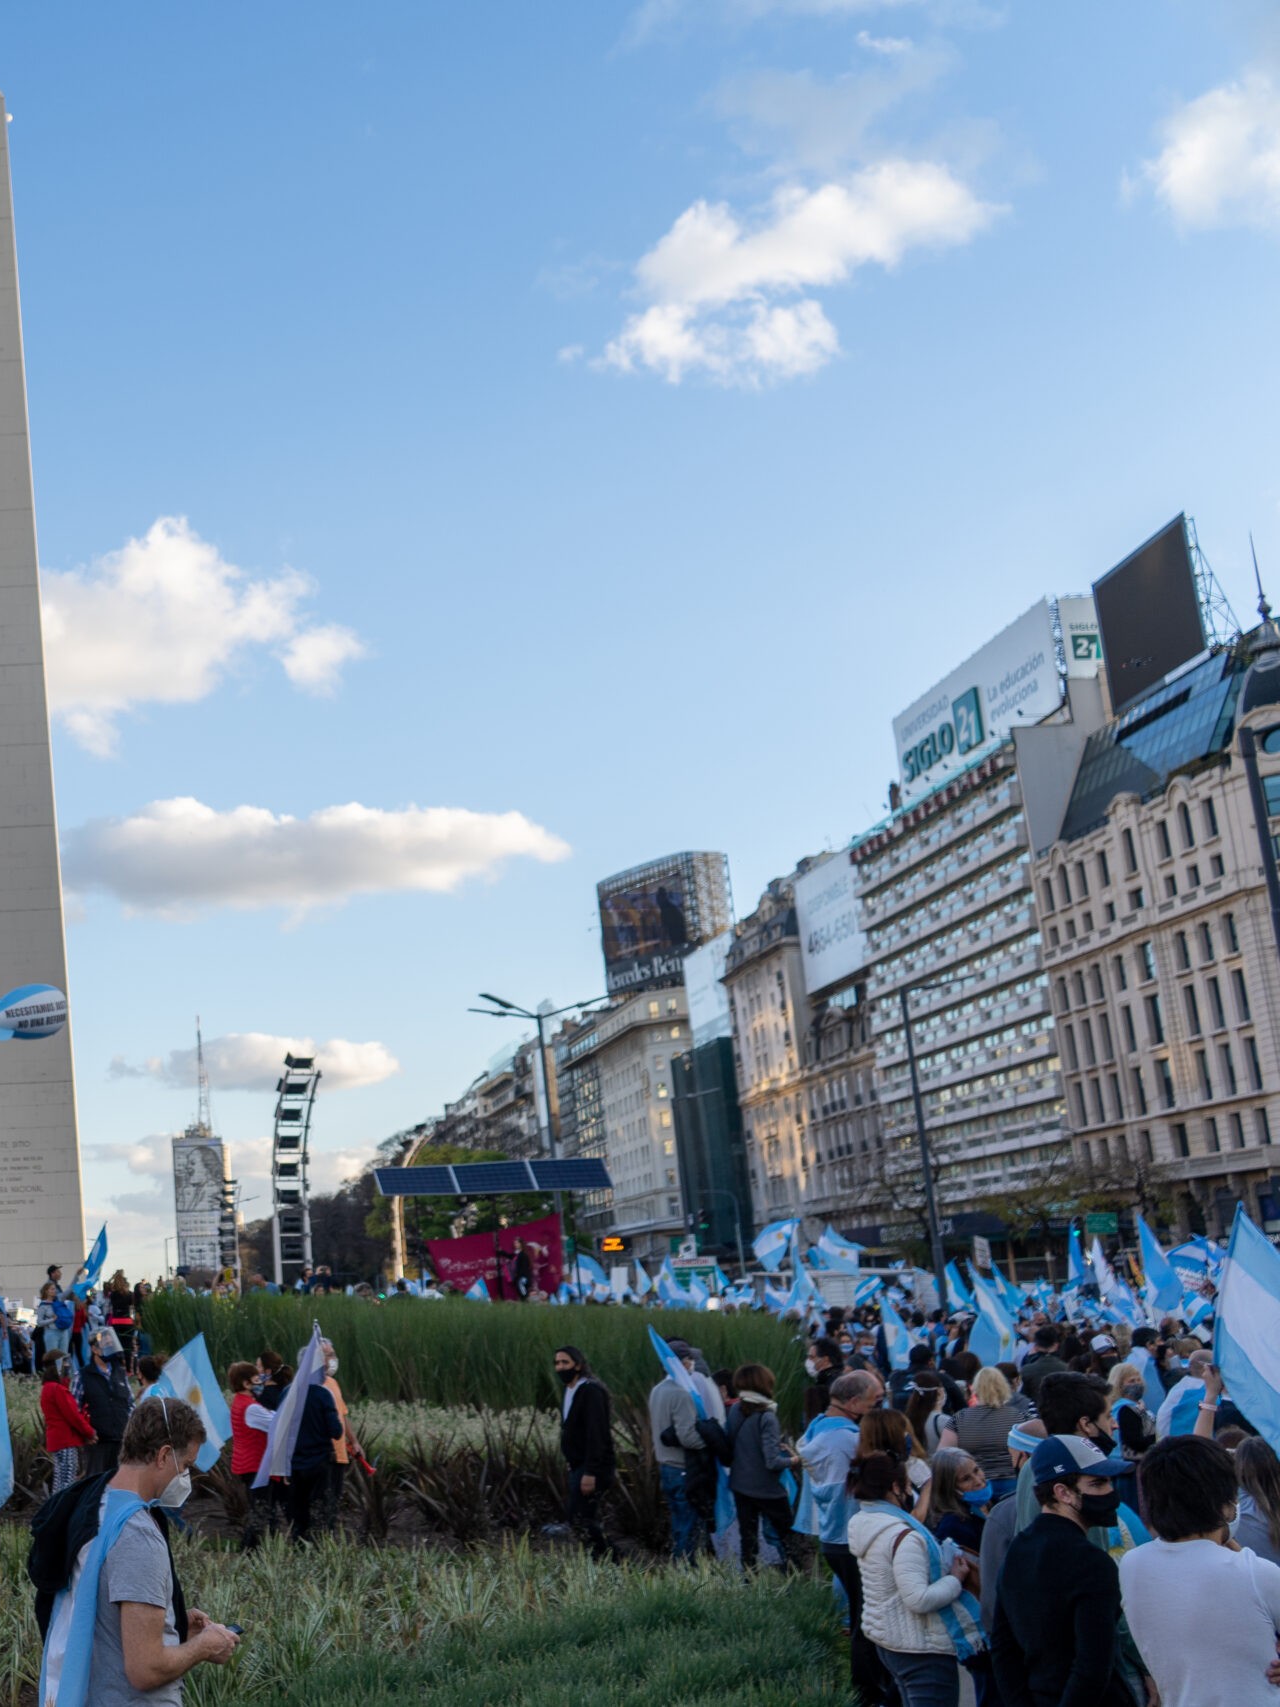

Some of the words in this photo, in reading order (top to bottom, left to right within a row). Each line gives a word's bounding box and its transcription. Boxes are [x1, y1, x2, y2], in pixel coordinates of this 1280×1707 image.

[987, 685, 999, 702] La
[1000, 652, 1045, 694] educación
[991, 679, 1039, 722] evoluciona
[902, 721, 954, 784] SIGLO
[5, 1002, 54, 1018] NECESITAMOS
[17, 1019, 29, 1029] NO
